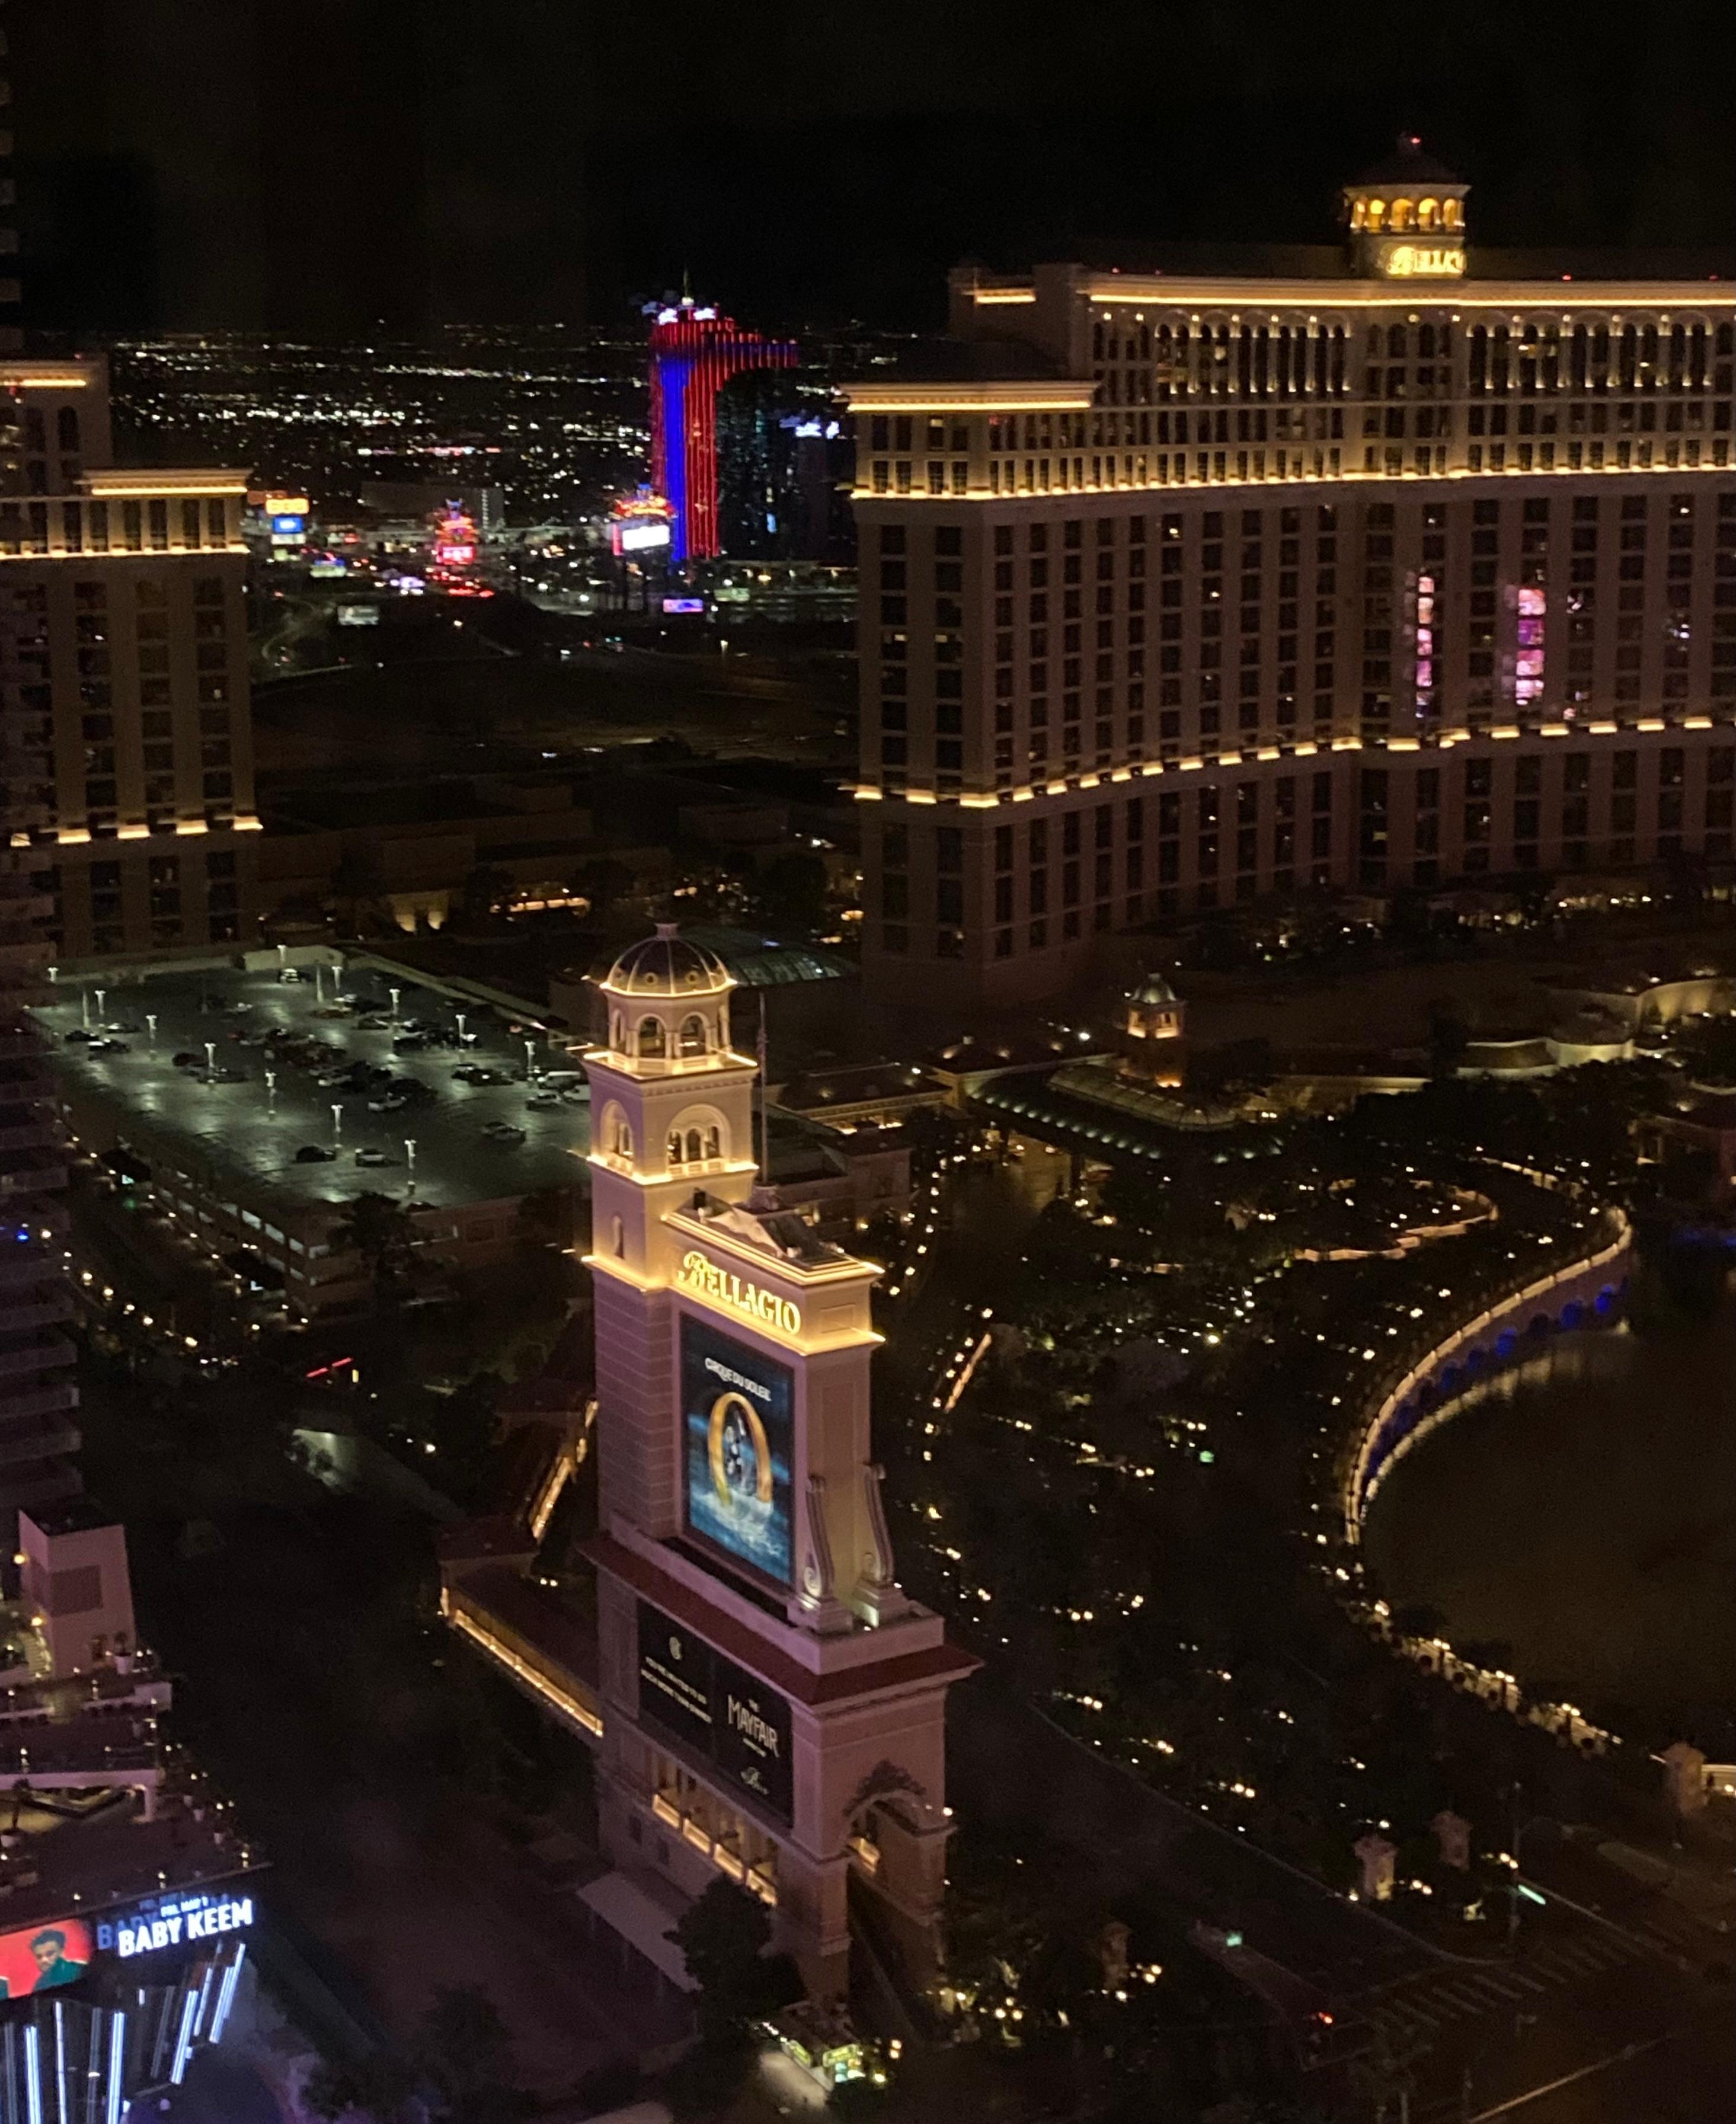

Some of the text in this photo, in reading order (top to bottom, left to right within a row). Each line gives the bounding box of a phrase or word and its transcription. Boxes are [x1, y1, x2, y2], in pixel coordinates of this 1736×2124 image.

[677, 1251, 801, 1336] BELLAGIO
[727, 1694, 781, 1758] MAYFAIR
[118, 1898, 253, 1957] BABY KEEM
